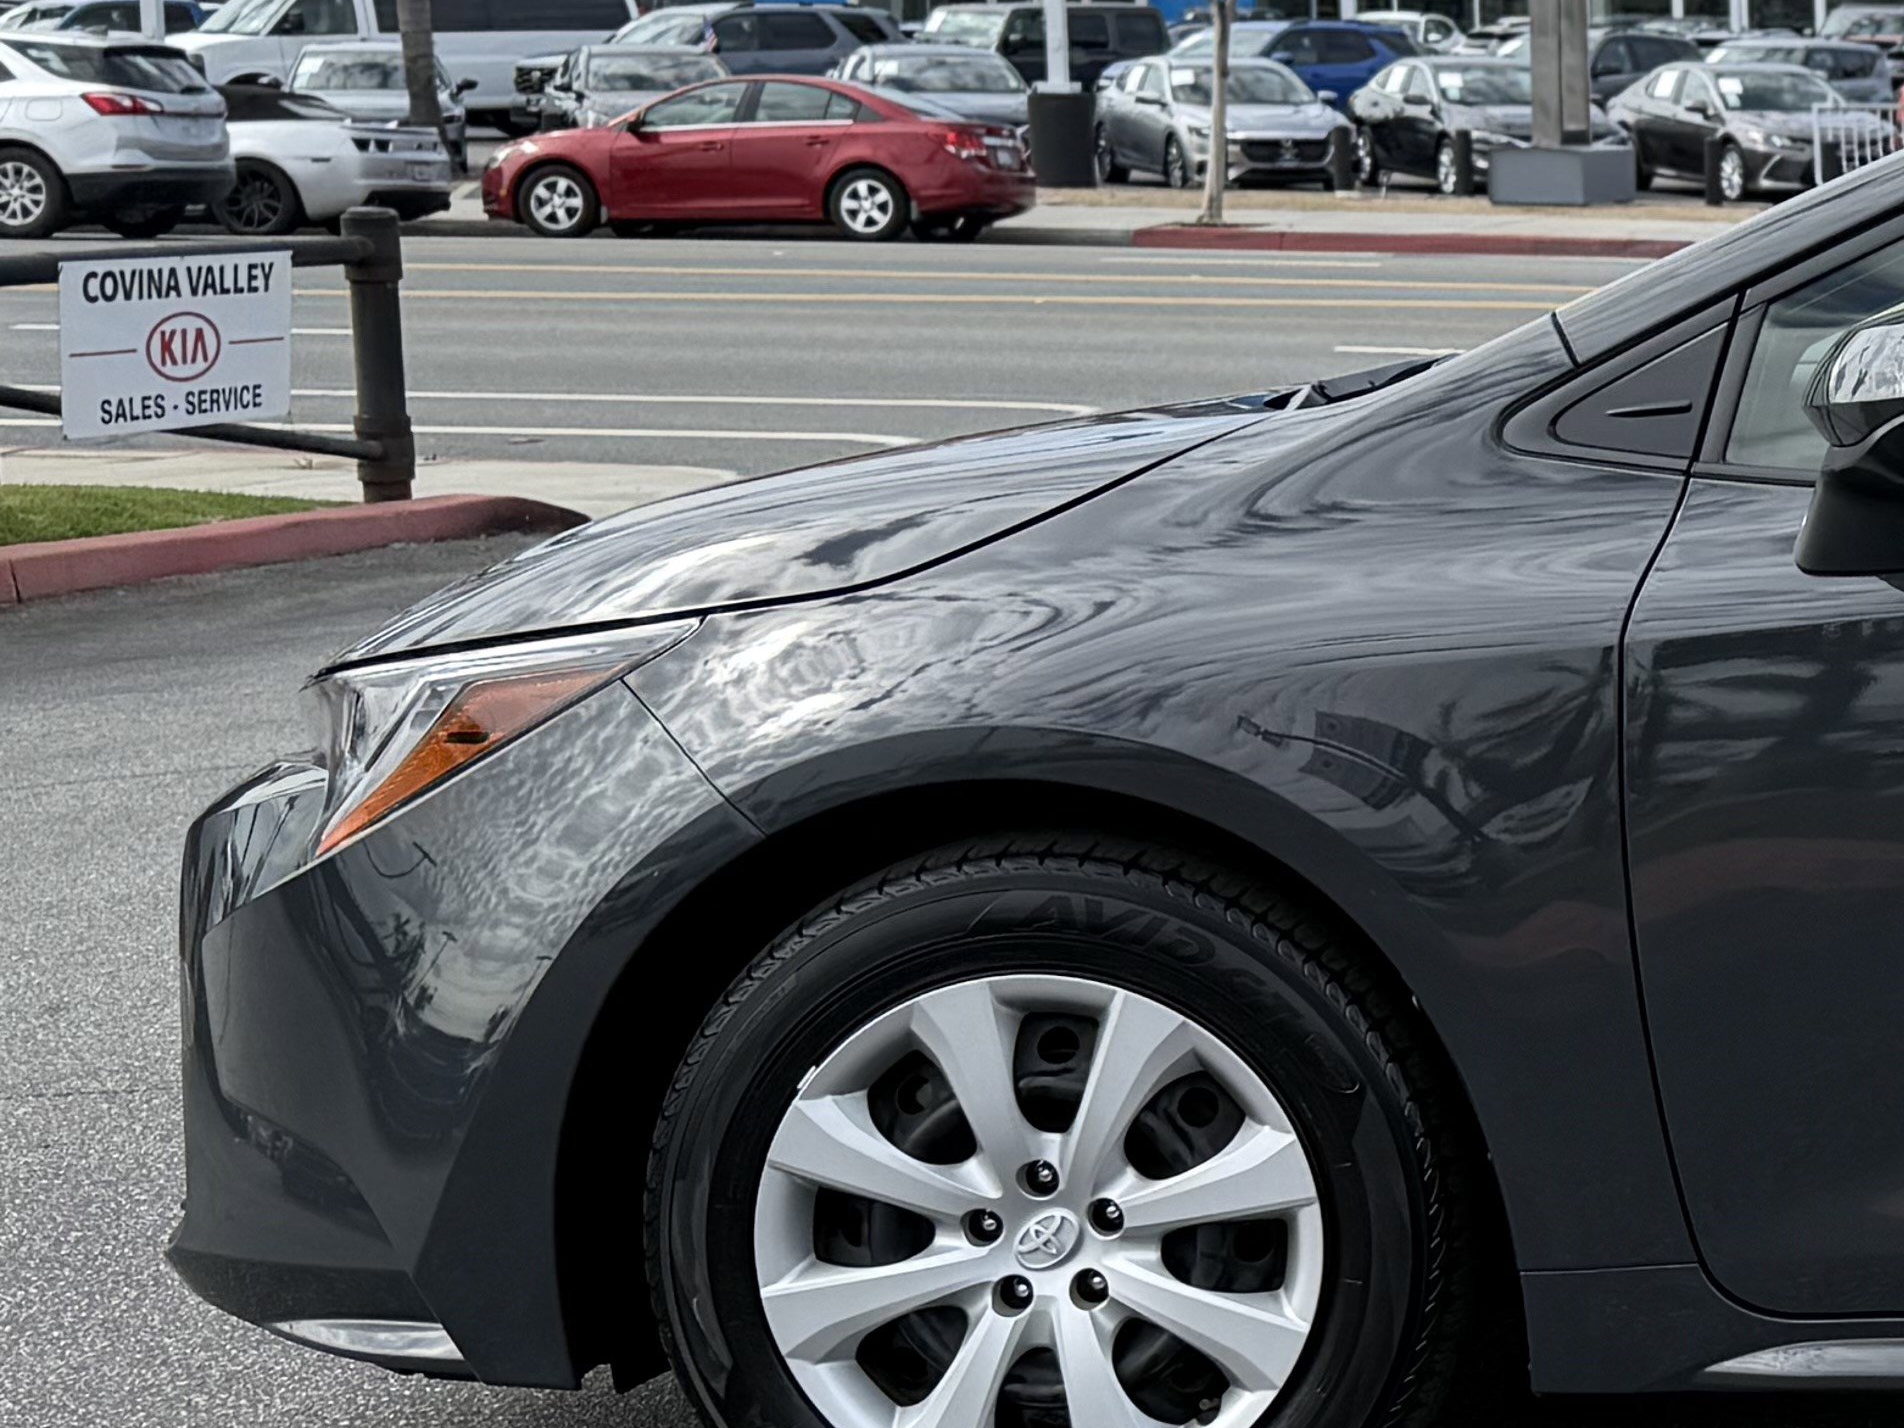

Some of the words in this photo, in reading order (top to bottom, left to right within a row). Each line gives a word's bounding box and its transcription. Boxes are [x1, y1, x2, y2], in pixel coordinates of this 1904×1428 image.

[82, 266, 182, 304] COVINA
[186, 262, 274, 298] VALLEY
[160, 327, 208, 367] KIA
[100, 394, 166, 425] SALES
[184, 384, 263, 416] SERVICE
